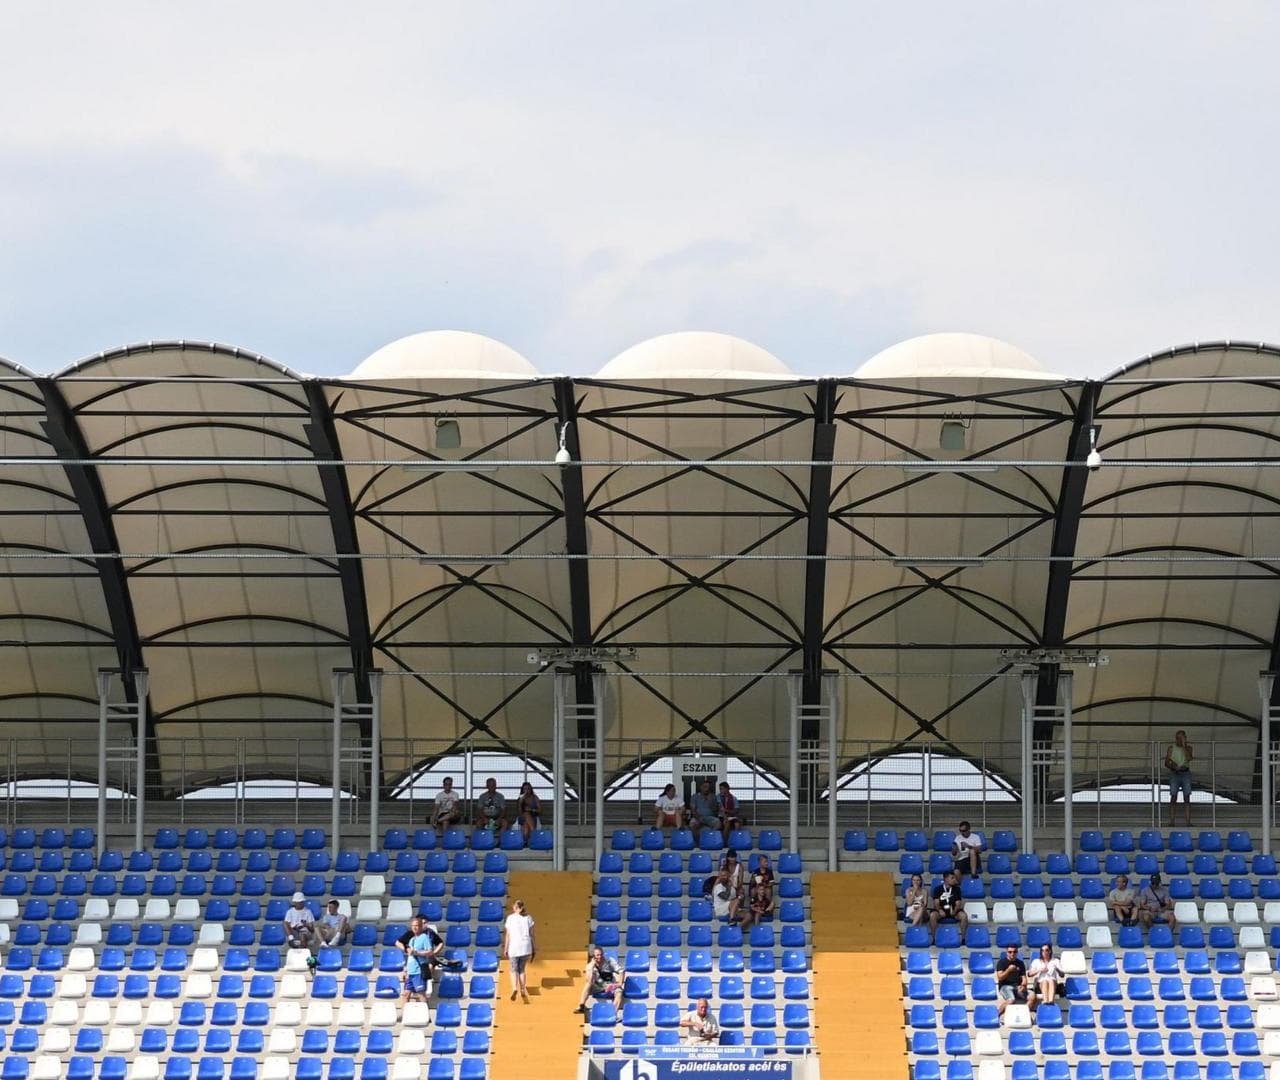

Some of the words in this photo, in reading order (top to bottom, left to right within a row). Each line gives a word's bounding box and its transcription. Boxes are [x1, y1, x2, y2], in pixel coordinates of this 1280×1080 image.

[671, 1060, 745, 1074] Épületlakatos
[749, 1061, 772, 1072] acél
[774, 1062, 787, 1072] és
